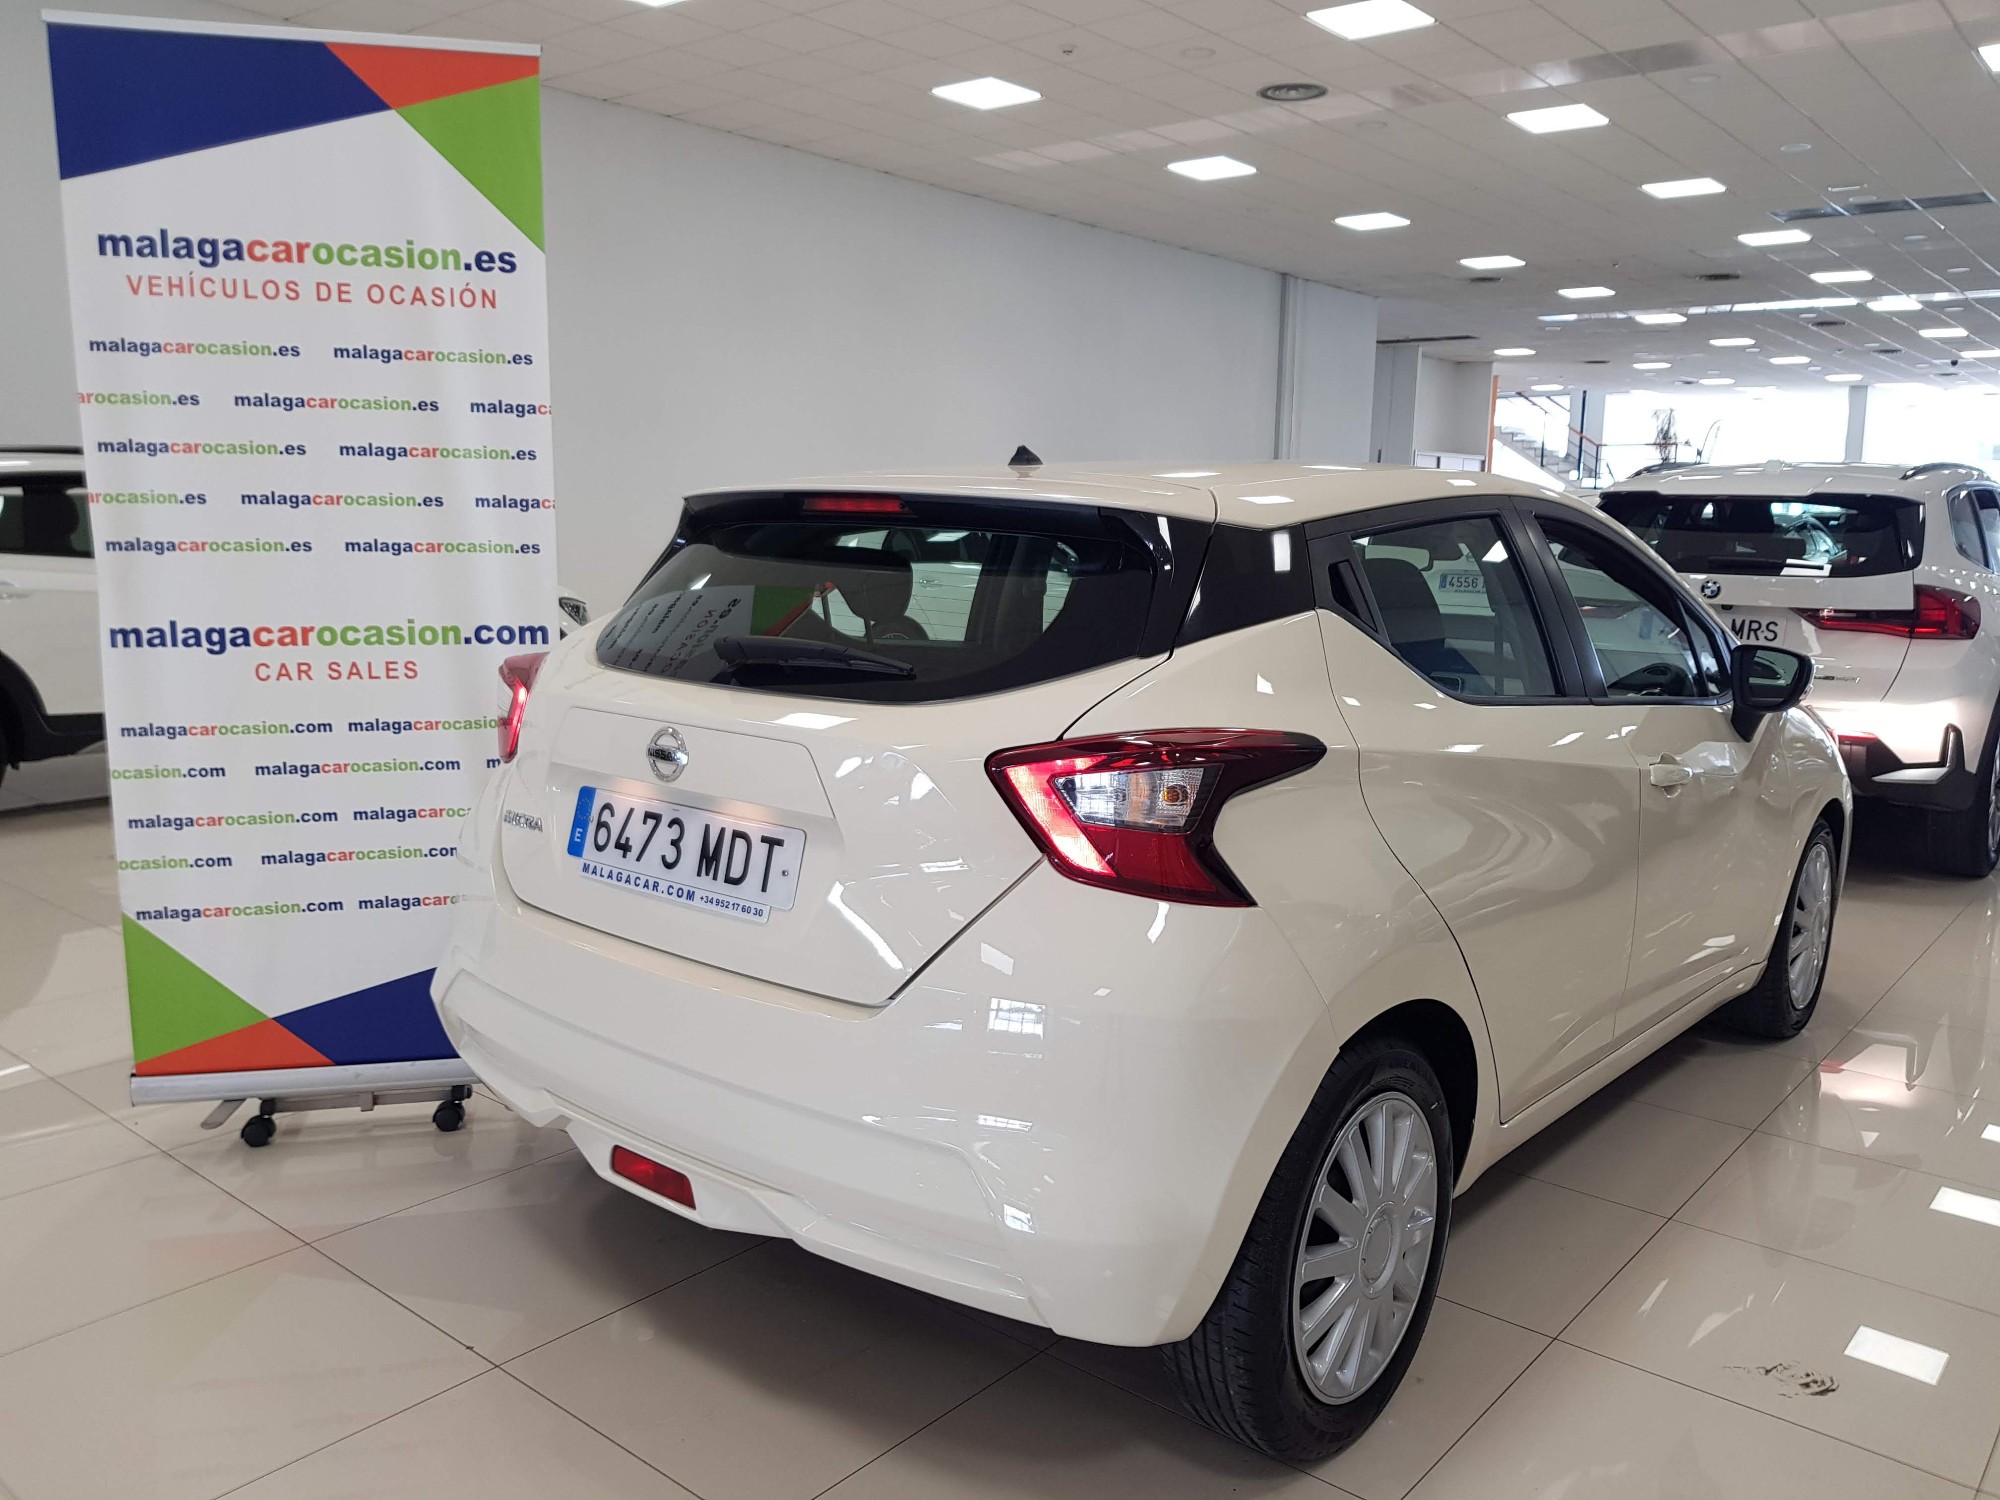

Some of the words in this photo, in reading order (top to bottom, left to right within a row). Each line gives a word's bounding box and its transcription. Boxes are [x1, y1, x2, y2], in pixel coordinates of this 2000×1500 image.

[97, 227, 519, 274] malagacarocasion.es
[126, 270, 301, 302] VEHÍCULOS
[315, 281, 353, 303] DE
[366, 282, 497, 310] OCASIÓN
[88, 336, 301, 358] malagacarocasion.es
[333, 344, 534, 366] malagacarocasion.es
[234, 392, 440, 412] malagacarocasion.es
[96, 438, 307, 458] malagacarocasion.es
[339, 441, 538, 462] malagacarocasion.es
[240, 490, 445, 510] malagacarocasion.es
[105, 536, 313, 556] malagacarocasion.es
[344, 537, 541, 557] malagacarocasion.es
[1448, 577, 1479, 589] 4556
[109, 618, 550, 659] malagacarocasion.com
[1731, 618, 1778, 642] MRS
[254, 661, 314, 682] CAR
[327, 660, 419, 681] SALES
[120, 720, 334, 741] malagacarocasion.com
[111, 765, 227, 780] ocasion.com
[254, 758, 461, 779] malagacarocasion.com
[127, 810, 339, 832] malagacarocasion.com
[573, 827, 583, 843] E
[593, 801, 686, 870] 6473
[696, 823, 785, 893] MDT
[117, 855, 233, 871] ocasion.com
[582, 862, 696, 902] MALAGACAR.COM
[135, 900, 345, 922] malagacarocasion.com
